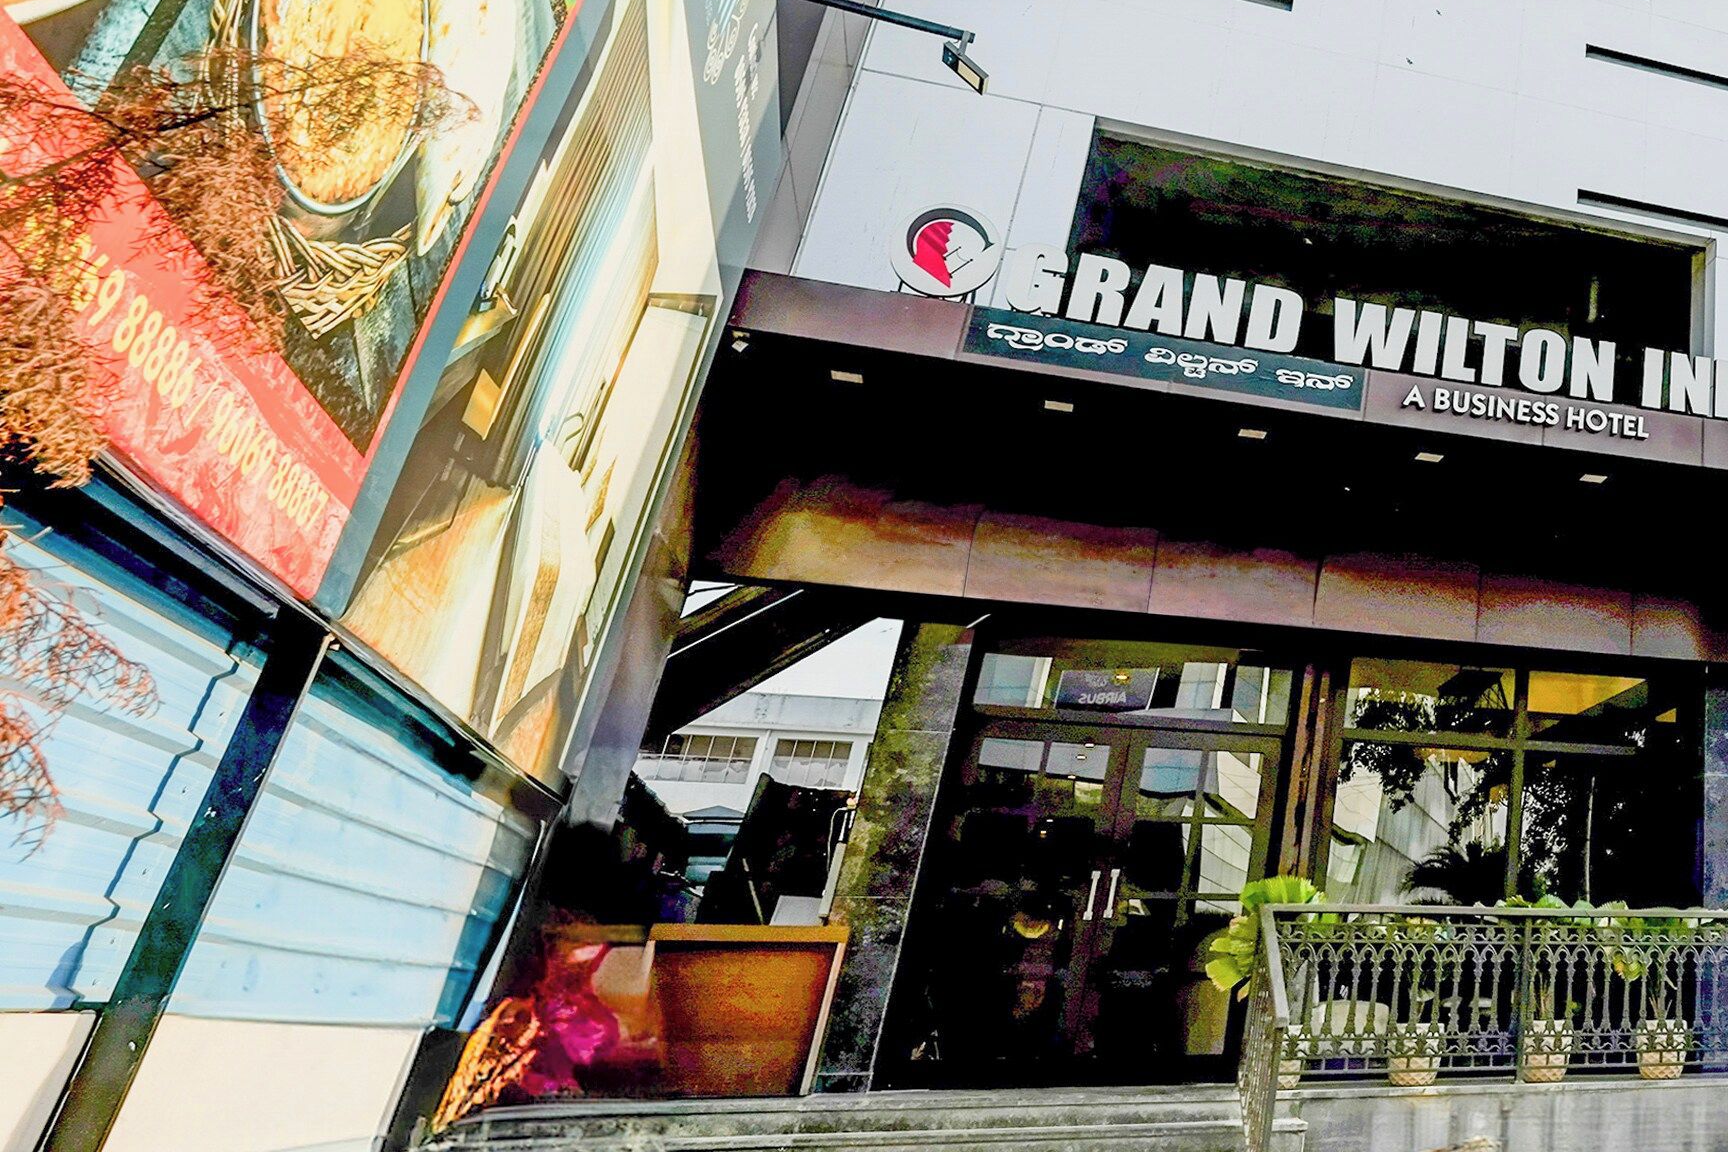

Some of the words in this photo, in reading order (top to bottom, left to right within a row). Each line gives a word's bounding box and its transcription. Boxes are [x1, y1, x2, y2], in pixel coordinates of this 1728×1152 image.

[986, 321, 1128, 353] ಗ್ರಾಂಡ್
[1144, 346, 1258, 378] ವಿಲ್ಟನ್
[1276, 368, 1353, 390] ಇನ್
[1005, 242, 1304, 354] GRAND
[1332, 297, 1619, 402] WILTON
[112, 293, 203, 409] 88886
[205, 395, 275, 478] 96069
[267, 454, 332, 530] 88887
[1402, 387, 1427, 410] A
[1433, 387, 1559, 426] BUSINESS
[1565, 404, 1650, 440] HOTEL
